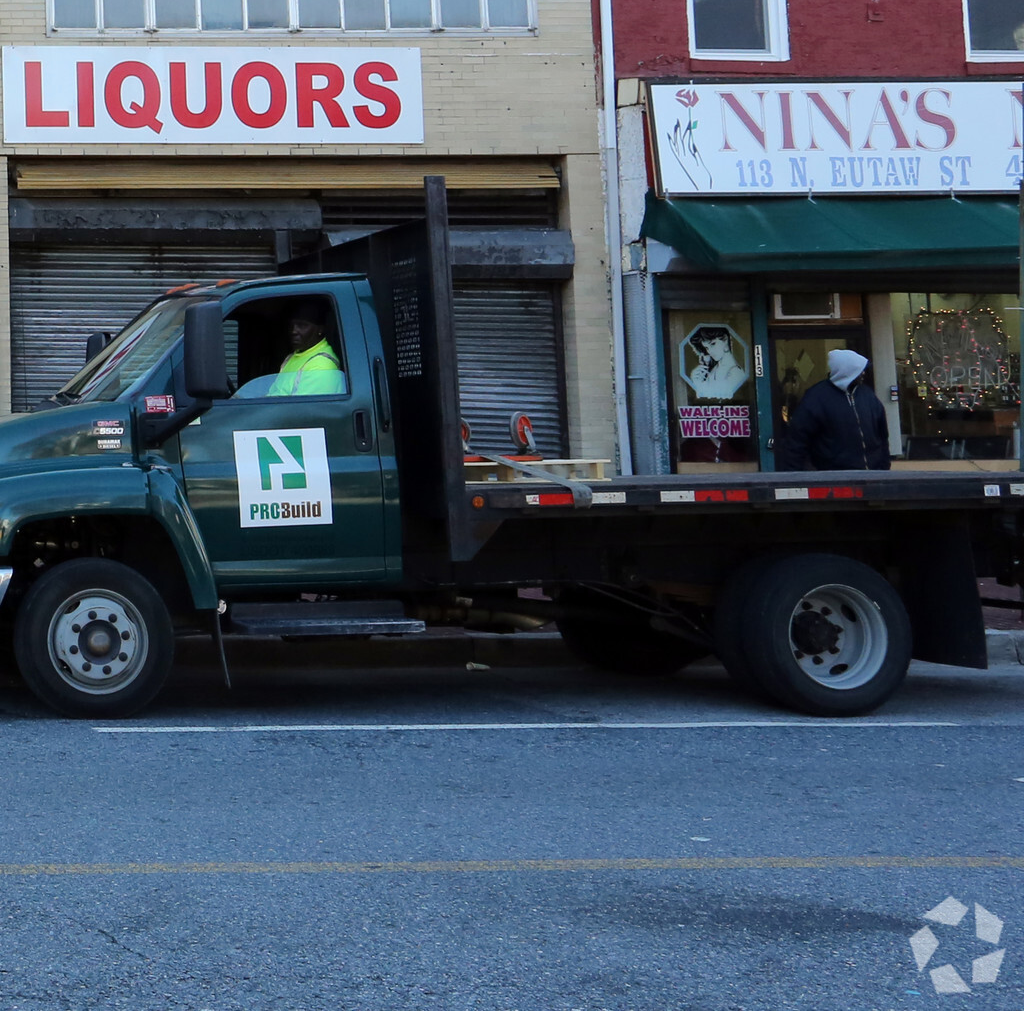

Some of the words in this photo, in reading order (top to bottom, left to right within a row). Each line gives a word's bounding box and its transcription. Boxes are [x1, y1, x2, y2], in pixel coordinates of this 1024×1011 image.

[24, 60, 402, 135] LIQUORS
[714, 86, 957, 152] NINA'S
[736, 159, 774, 188] 113
[789, 156, 814, 188] N.
[829, 156, 921, 188] EUTAW
[939, 155, 972, 187] ST
[678, 405, 750, 418] WALK-INS
[679, 418, 751, 438] WELCOME
[250, 501, 322, 520] PROBuild
